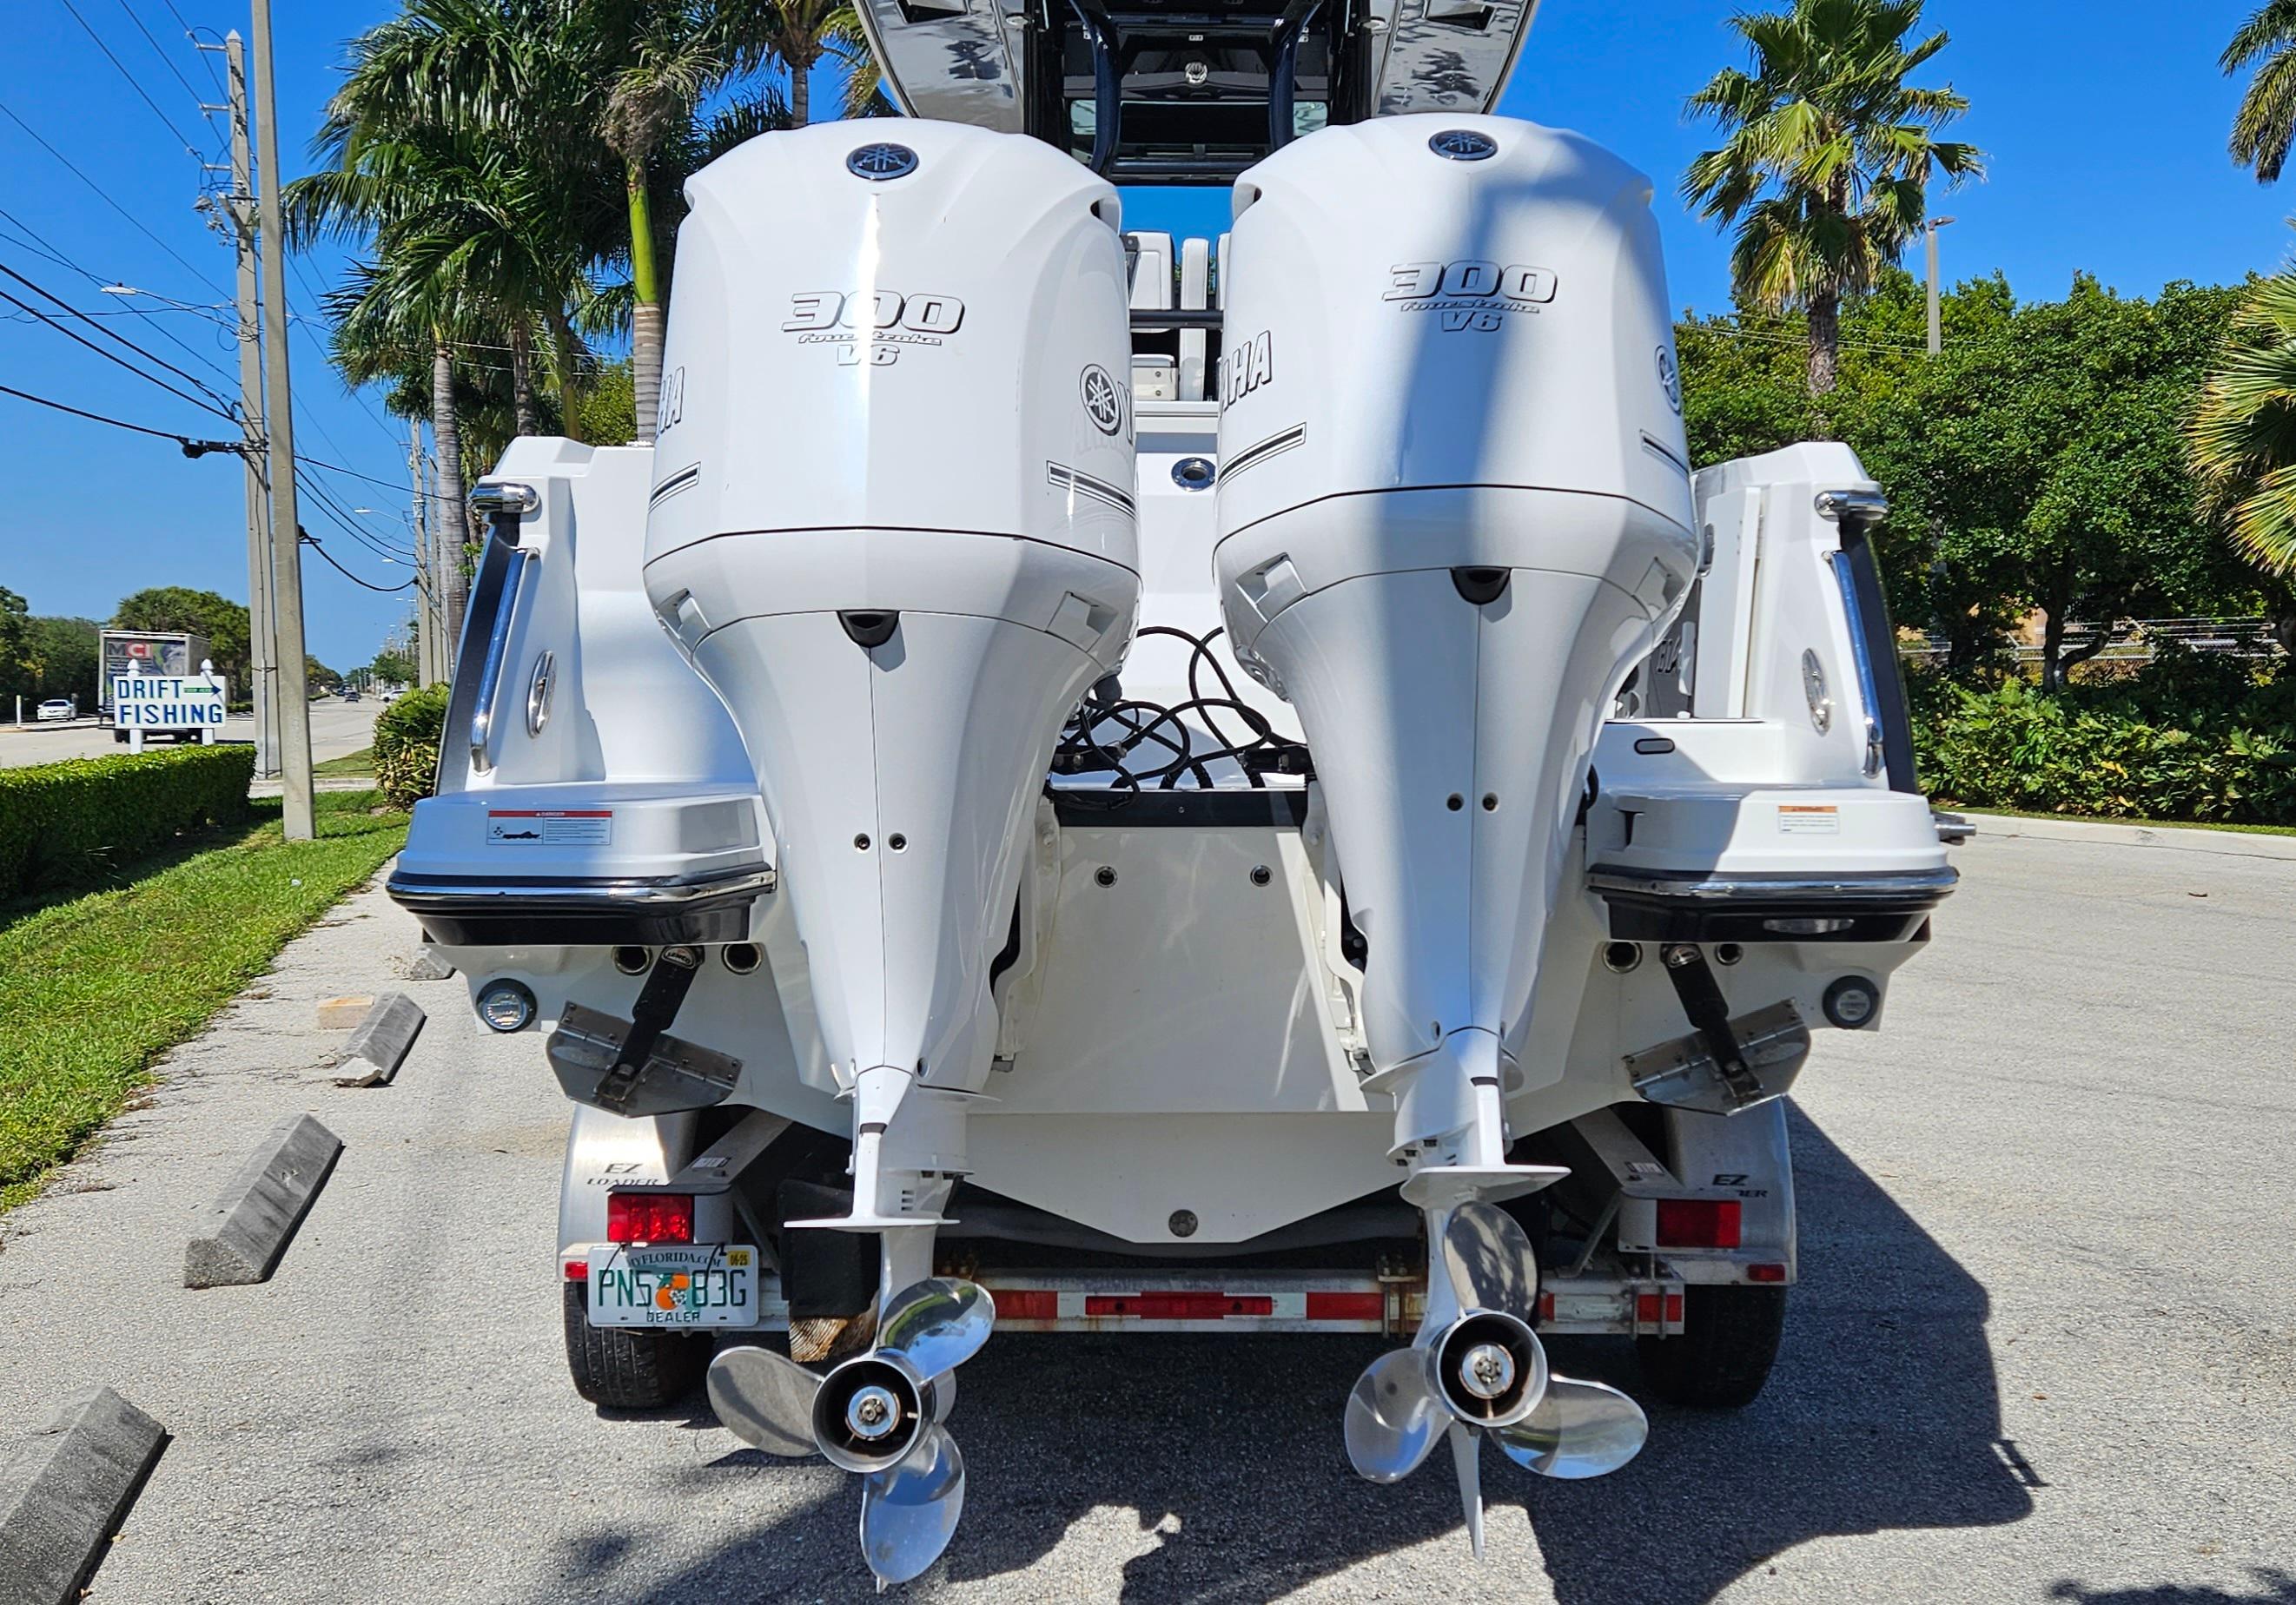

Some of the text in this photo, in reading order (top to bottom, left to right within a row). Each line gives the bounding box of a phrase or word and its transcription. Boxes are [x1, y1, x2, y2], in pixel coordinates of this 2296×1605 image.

[1381, 260, 1558, 304] 300
[781, 290, 965, 334] 300
[1441, 310, 1503, 332] V6
[798, 331, 942, 346] fourtroke
[837, 344, 901, 366] V6
[117, 679, 183, 699] DRIFT
[120, 703, 222, 724] FISHING
[605, 1163, 643, 1174] EZ
[1712, 1173, 1749, 1186] EZ
[646, 1311, 701, 1323] DEALER
